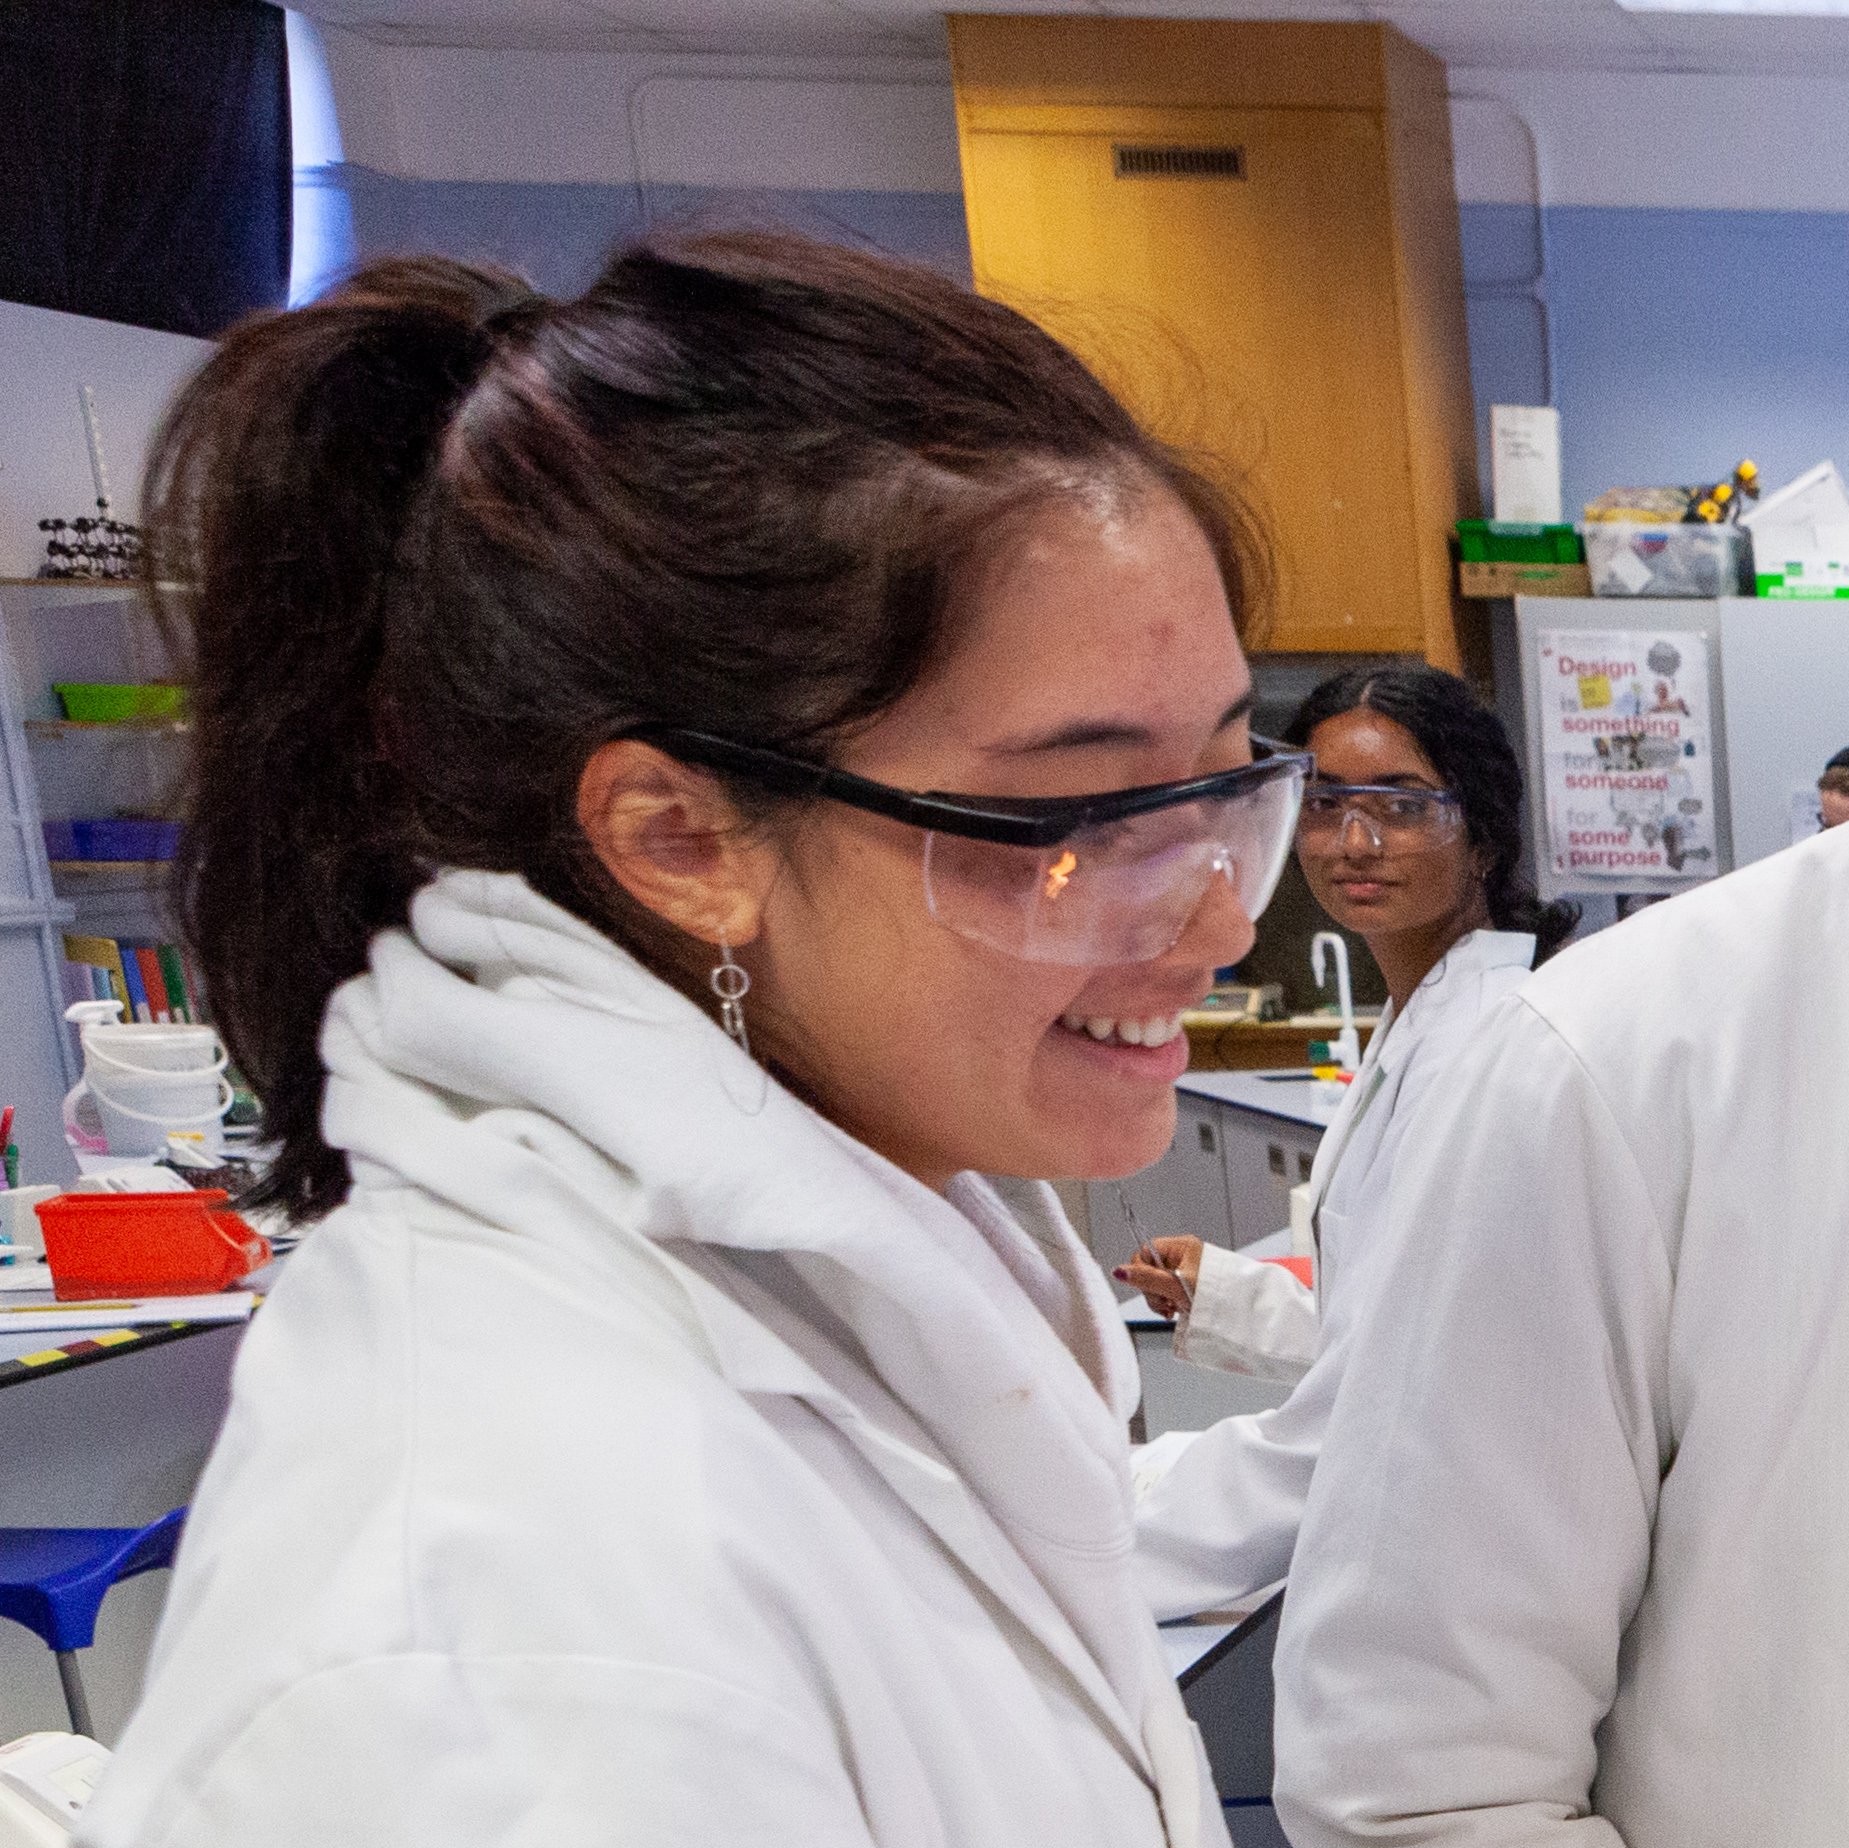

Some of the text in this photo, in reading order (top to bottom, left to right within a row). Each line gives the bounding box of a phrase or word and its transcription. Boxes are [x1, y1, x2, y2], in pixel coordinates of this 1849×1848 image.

[1558, 656, 1637, 682] Design
[1562, 717, 1680, 738] something
[1565, 774, 1668, 791] someone
[1568, 830, 1630, 846] some
[1569, 850, 1662, 868] purpose
